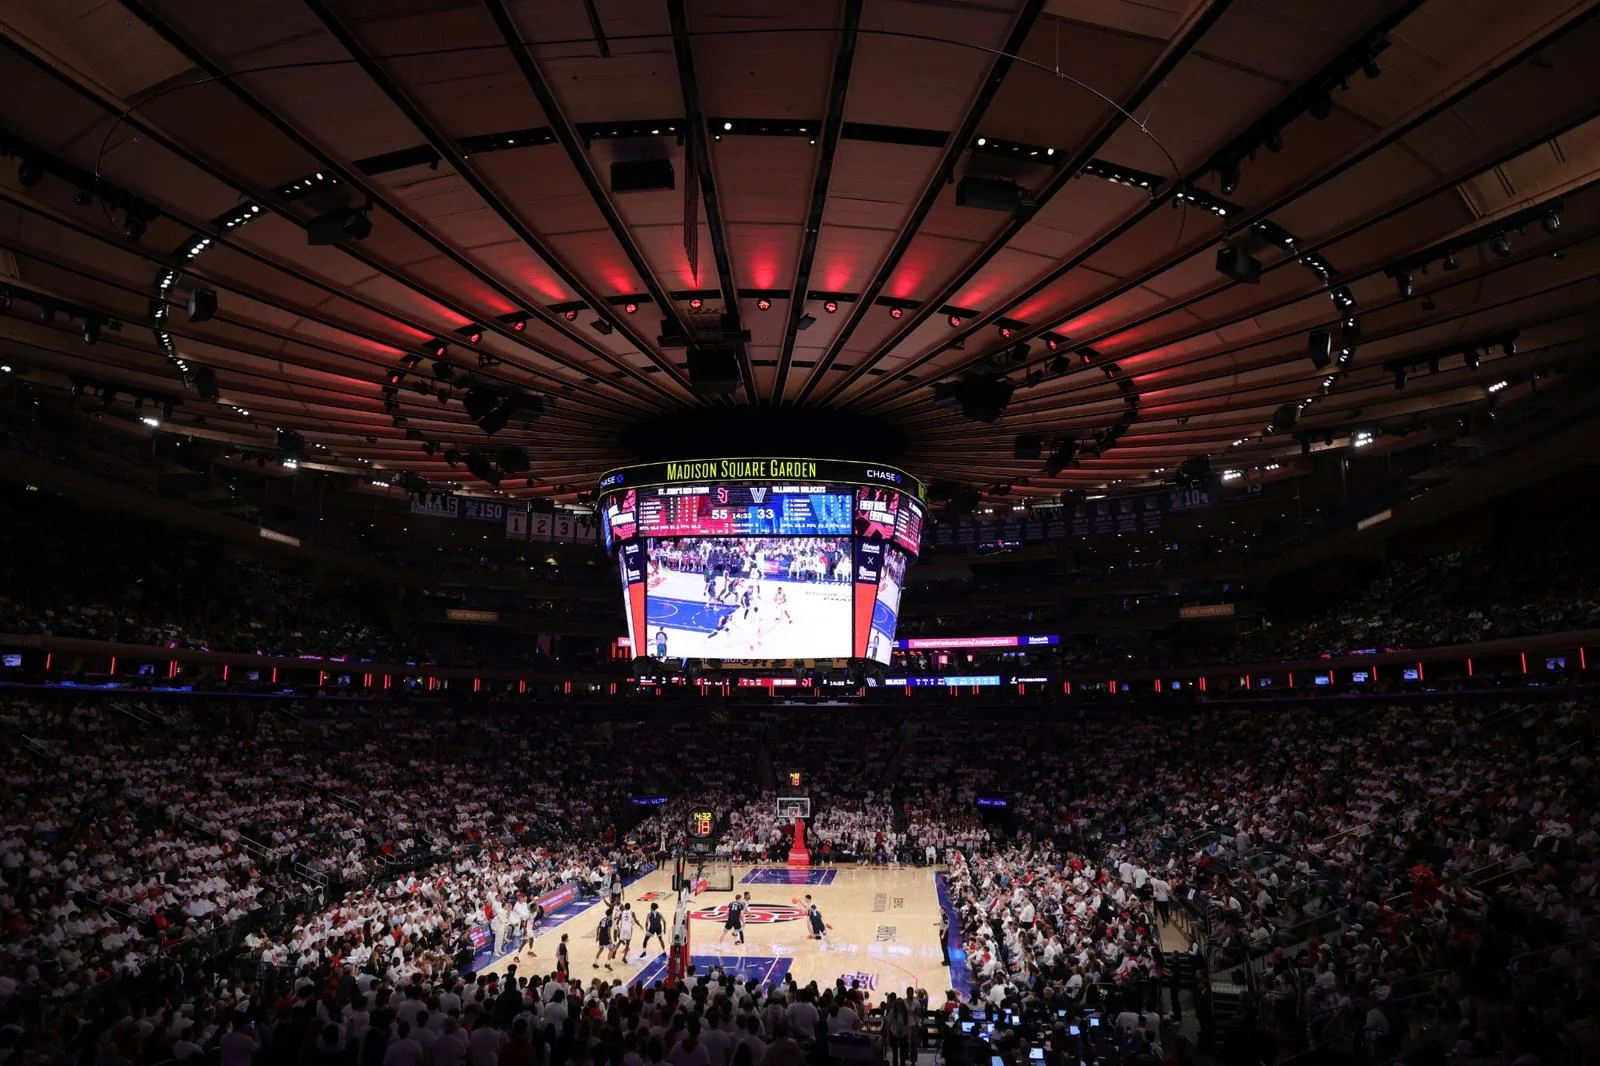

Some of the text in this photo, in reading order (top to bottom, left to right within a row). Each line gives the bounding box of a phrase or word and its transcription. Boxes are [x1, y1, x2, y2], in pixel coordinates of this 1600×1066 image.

[666, 459, 816, 481] MADISON SQUARE GARDEN
[866, 469, 896, 482] CHASE
[711, 509, 728, 520] 55
[757, 508, 774, 519] 33
[513, 517, 520, 532] 1
[537, 519, 546, 534] 2
[560, 521, 569, 536] 3
[693, 811, 712, 820] 14:32
[697, 820, 710, 834] 18
